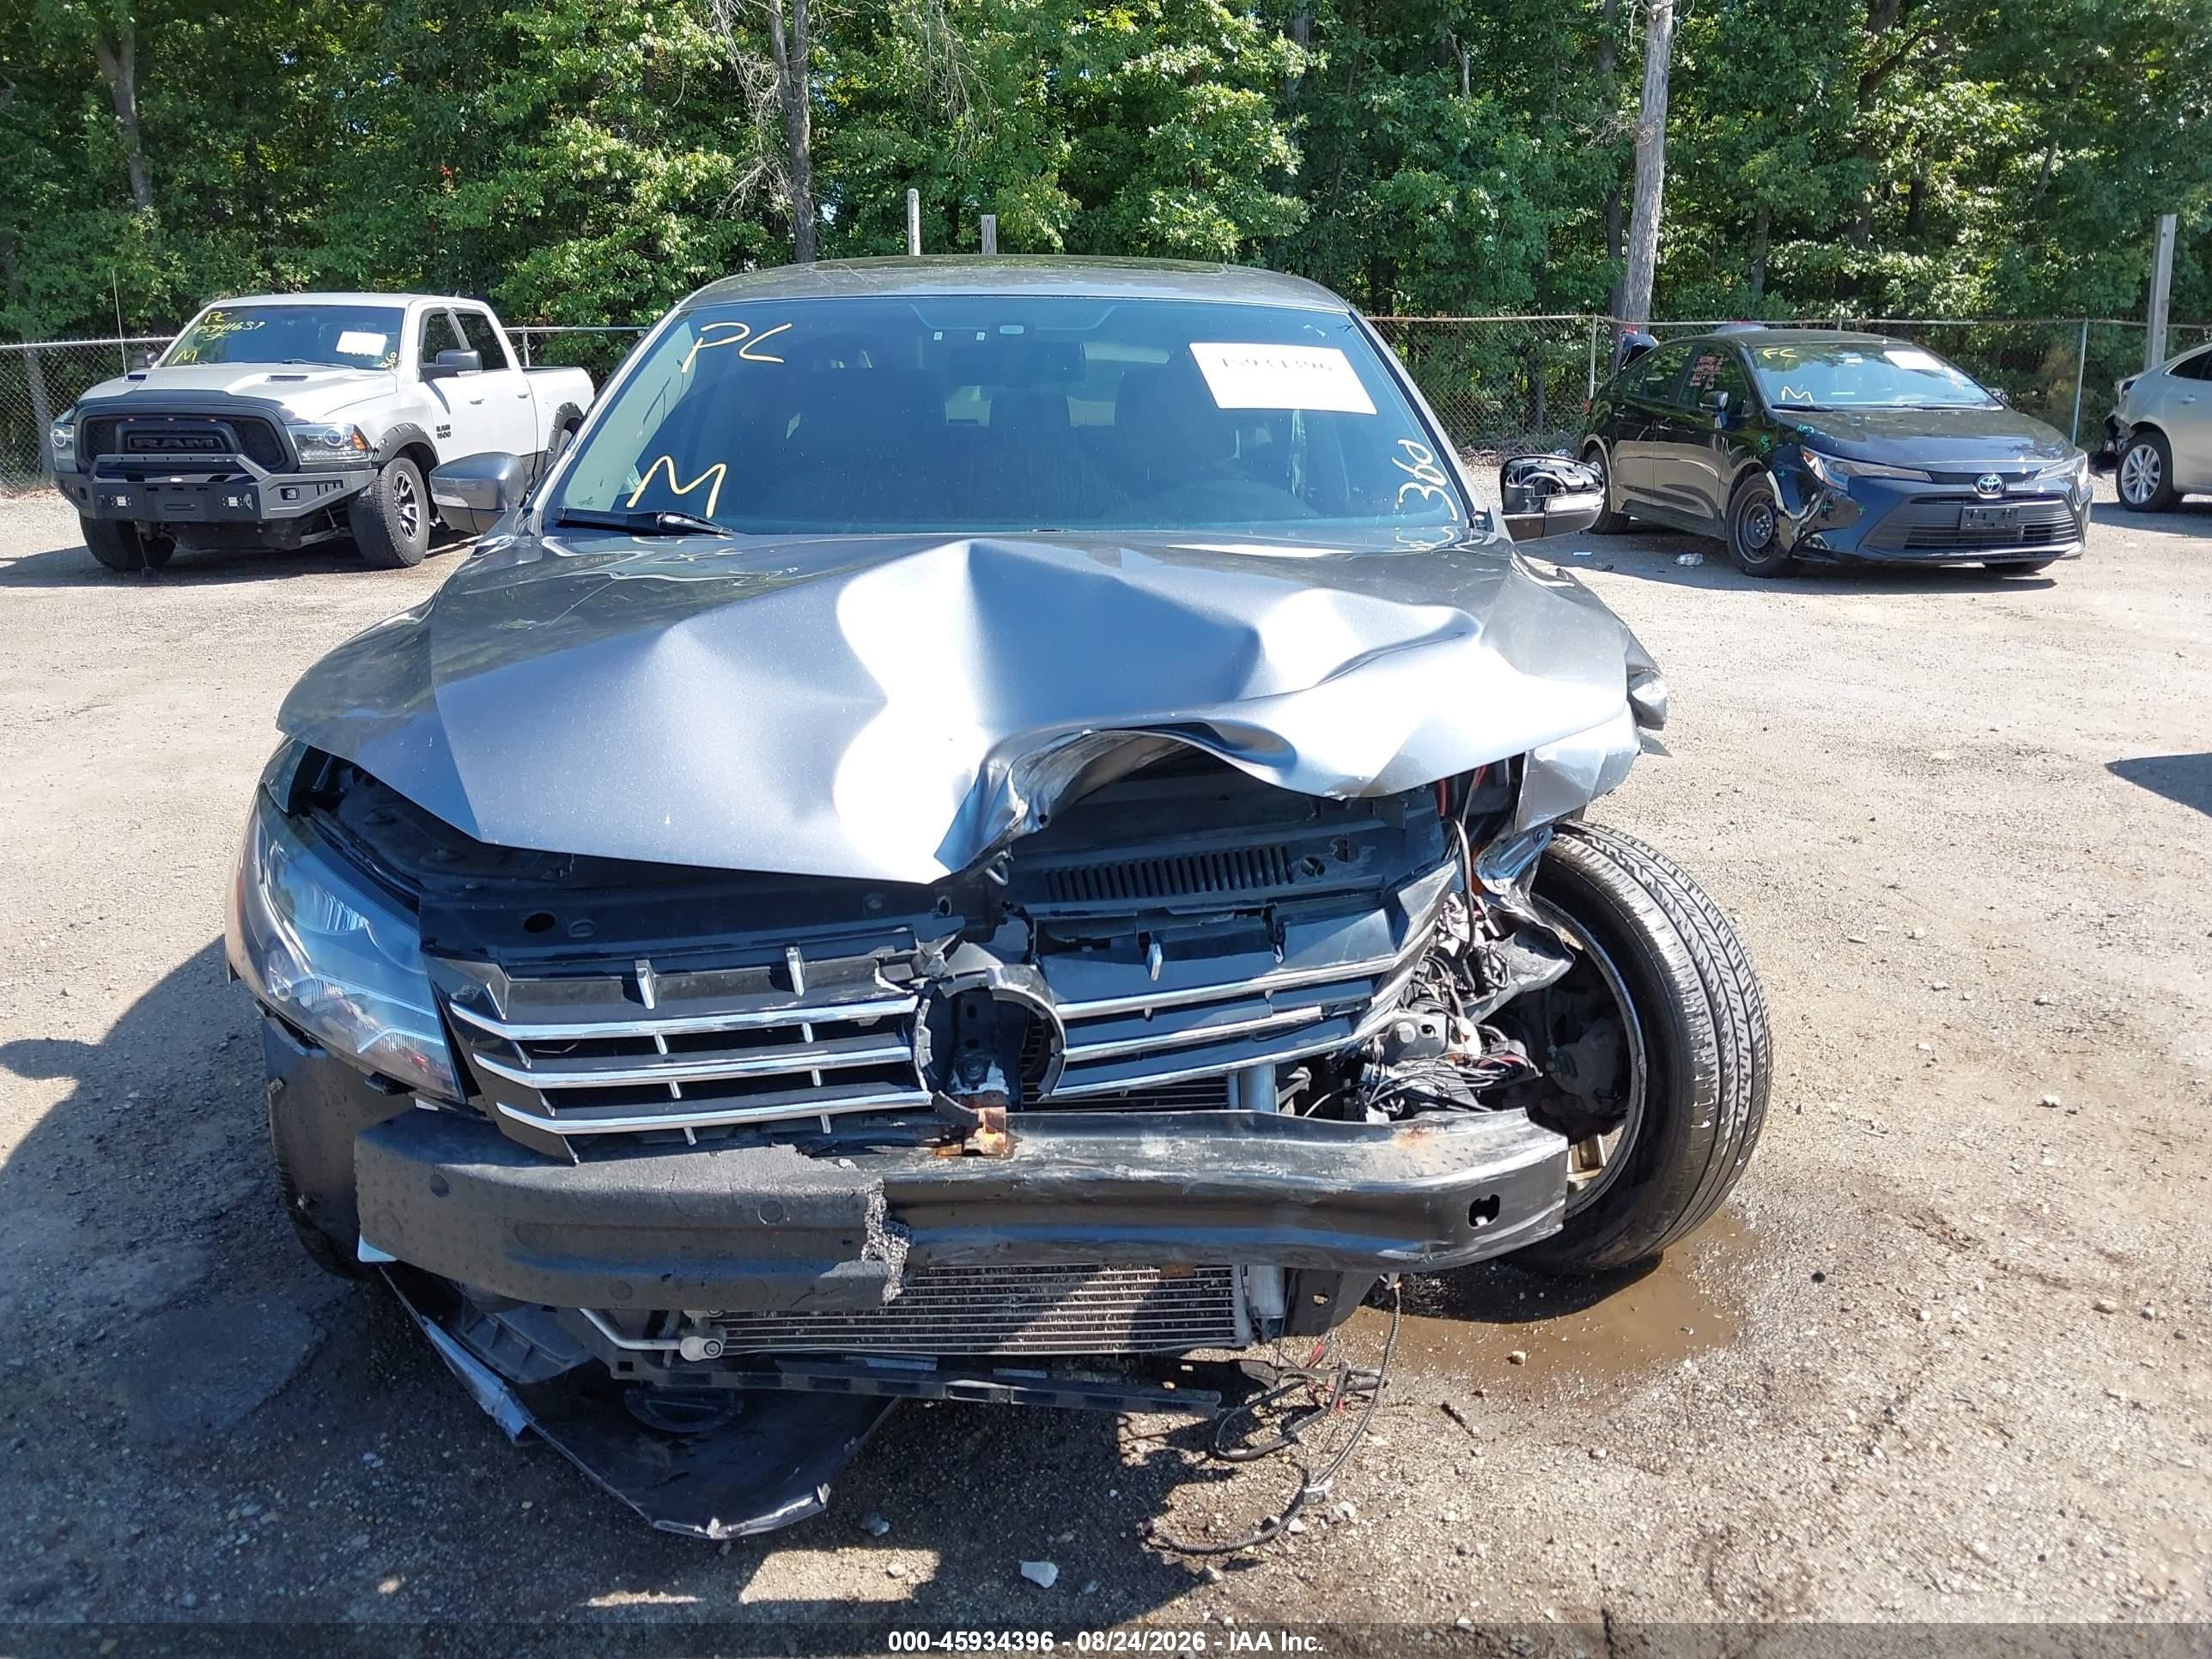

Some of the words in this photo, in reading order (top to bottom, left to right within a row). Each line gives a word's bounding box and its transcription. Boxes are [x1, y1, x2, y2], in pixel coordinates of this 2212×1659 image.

[680, 321, 793, 374] PC
[172, 349, 198, 365] M
[1780, 386, 1814, 404] M
[133, 439, 214, 448] RAM
[626, 455, 727, 519] M
